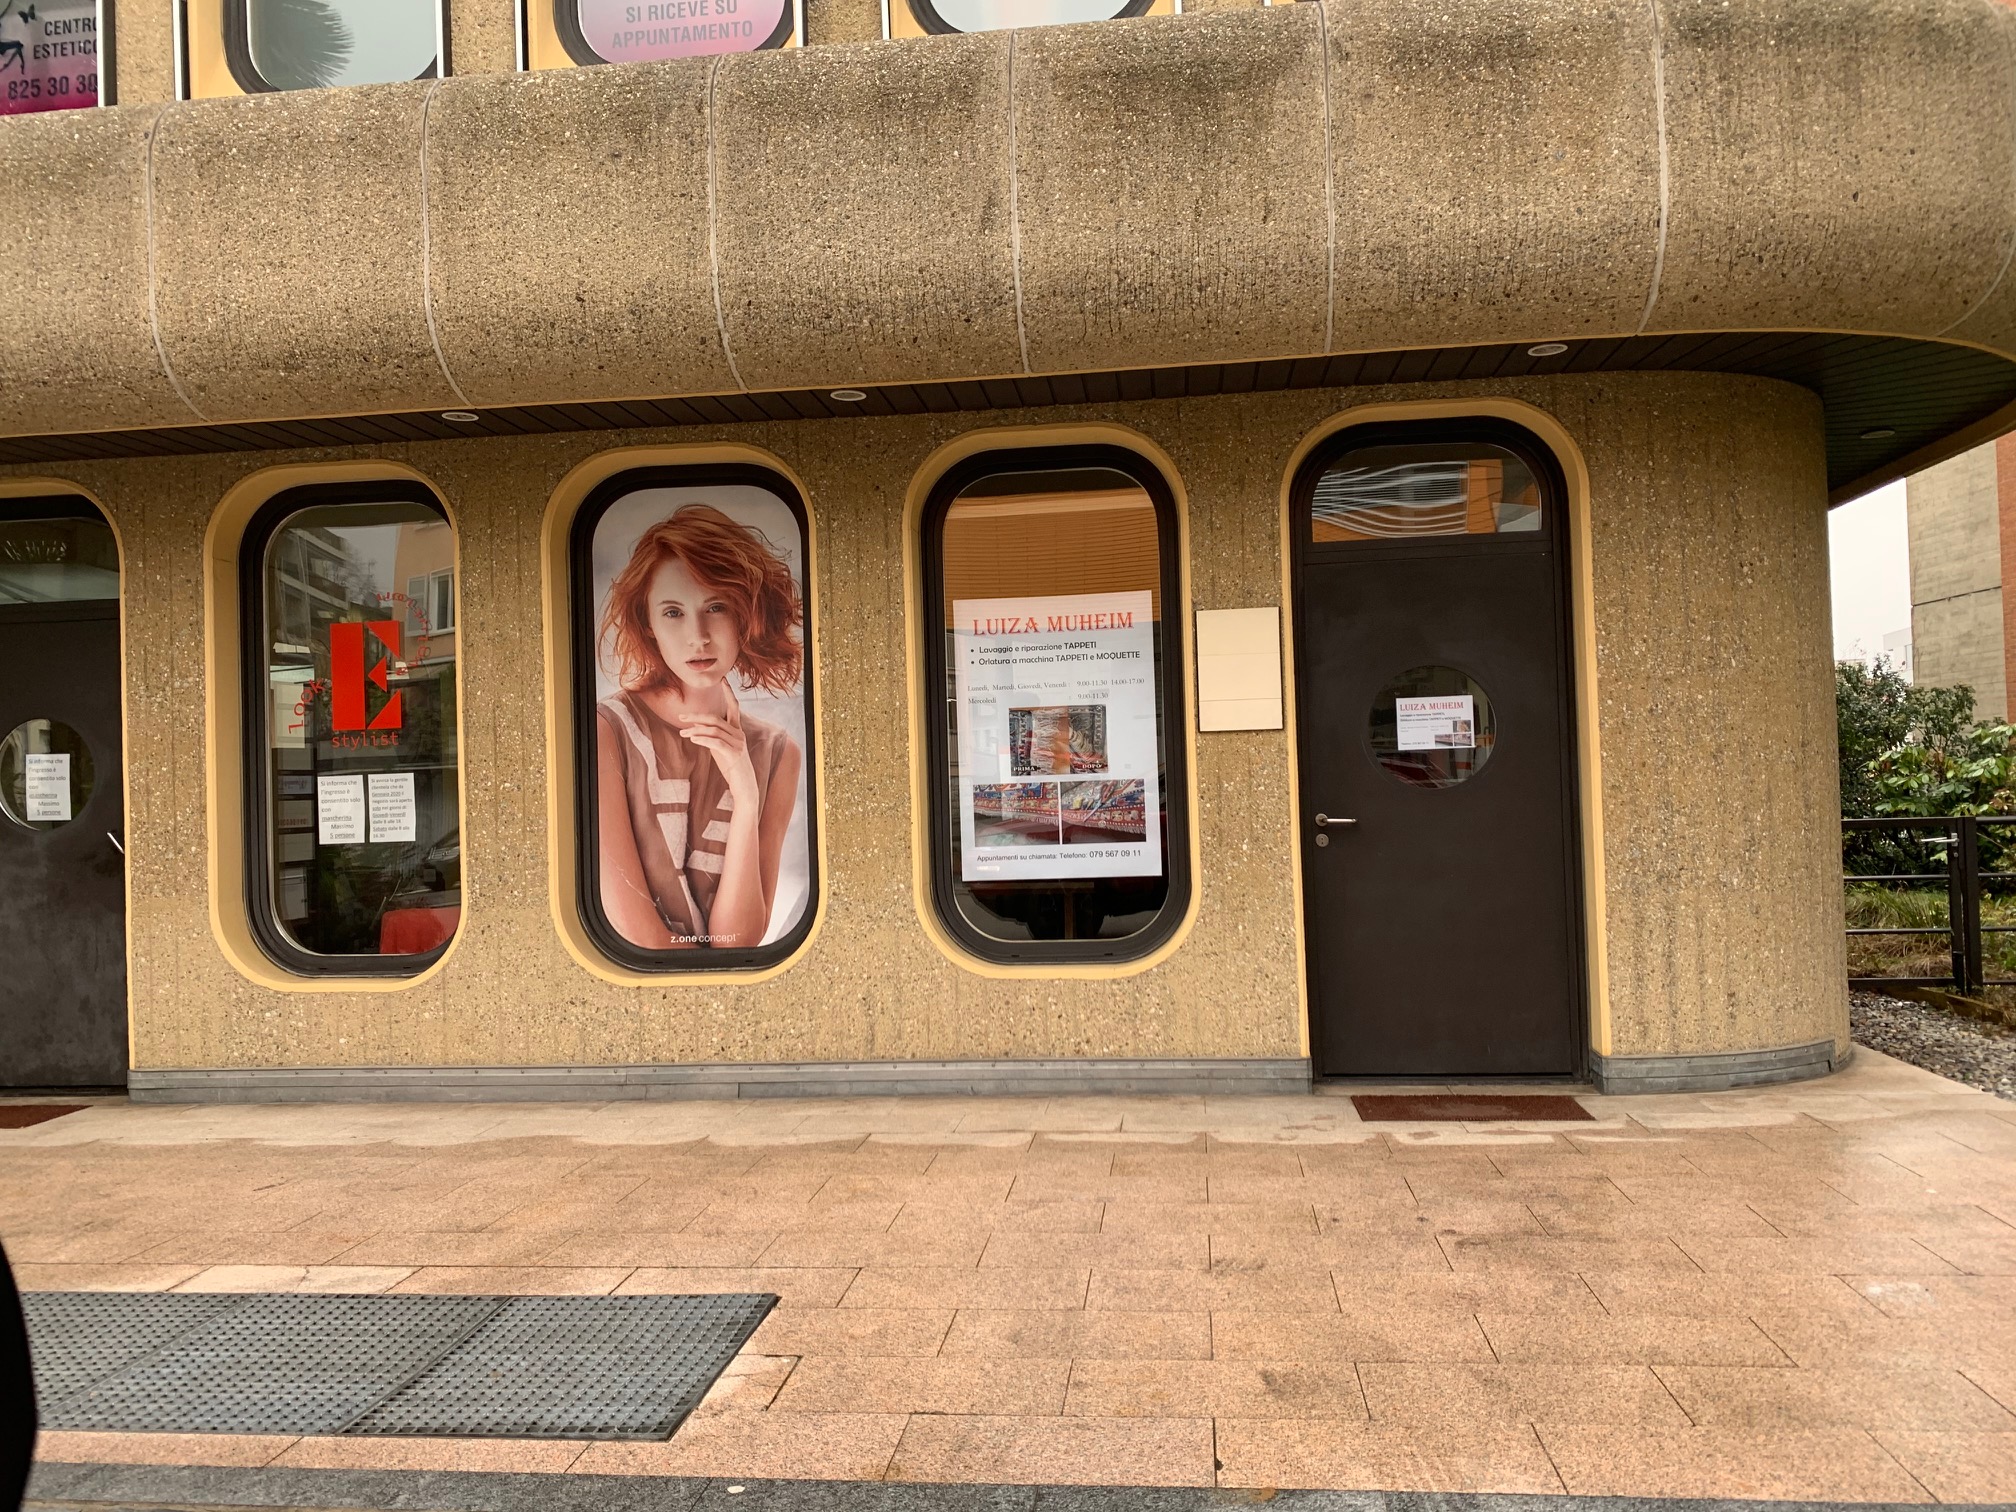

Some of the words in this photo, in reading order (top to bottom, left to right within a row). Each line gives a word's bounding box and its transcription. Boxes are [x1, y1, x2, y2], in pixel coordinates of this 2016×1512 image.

[626, 7, 641, 23] SI
[648, 0, 708, 20] RICEVE
[715, 0, 737, 14] SU
[612, 20, 753, 48] APPUNTAMENTO
[8, 79, 41, 100] 825
[47, 76, 69, 96] 30
[972, 616, 1040, 636] LUIZA
[1047, 612, 1134, 633] MUHEIM
[979, 646, 1013, 654] Lavaggio
[1021, 644, 1062, 652] riparazione
[1064, 641, 1096, 649] TAPPETI
[1096, 651, 1140, 660] MOQUETTE
[288, 679, 326, 734] look
[1429, 702, 1464, 710] MUHEIM
[332, 732, 399, 751] stylist
[670, 935, 697, 943] z.one
